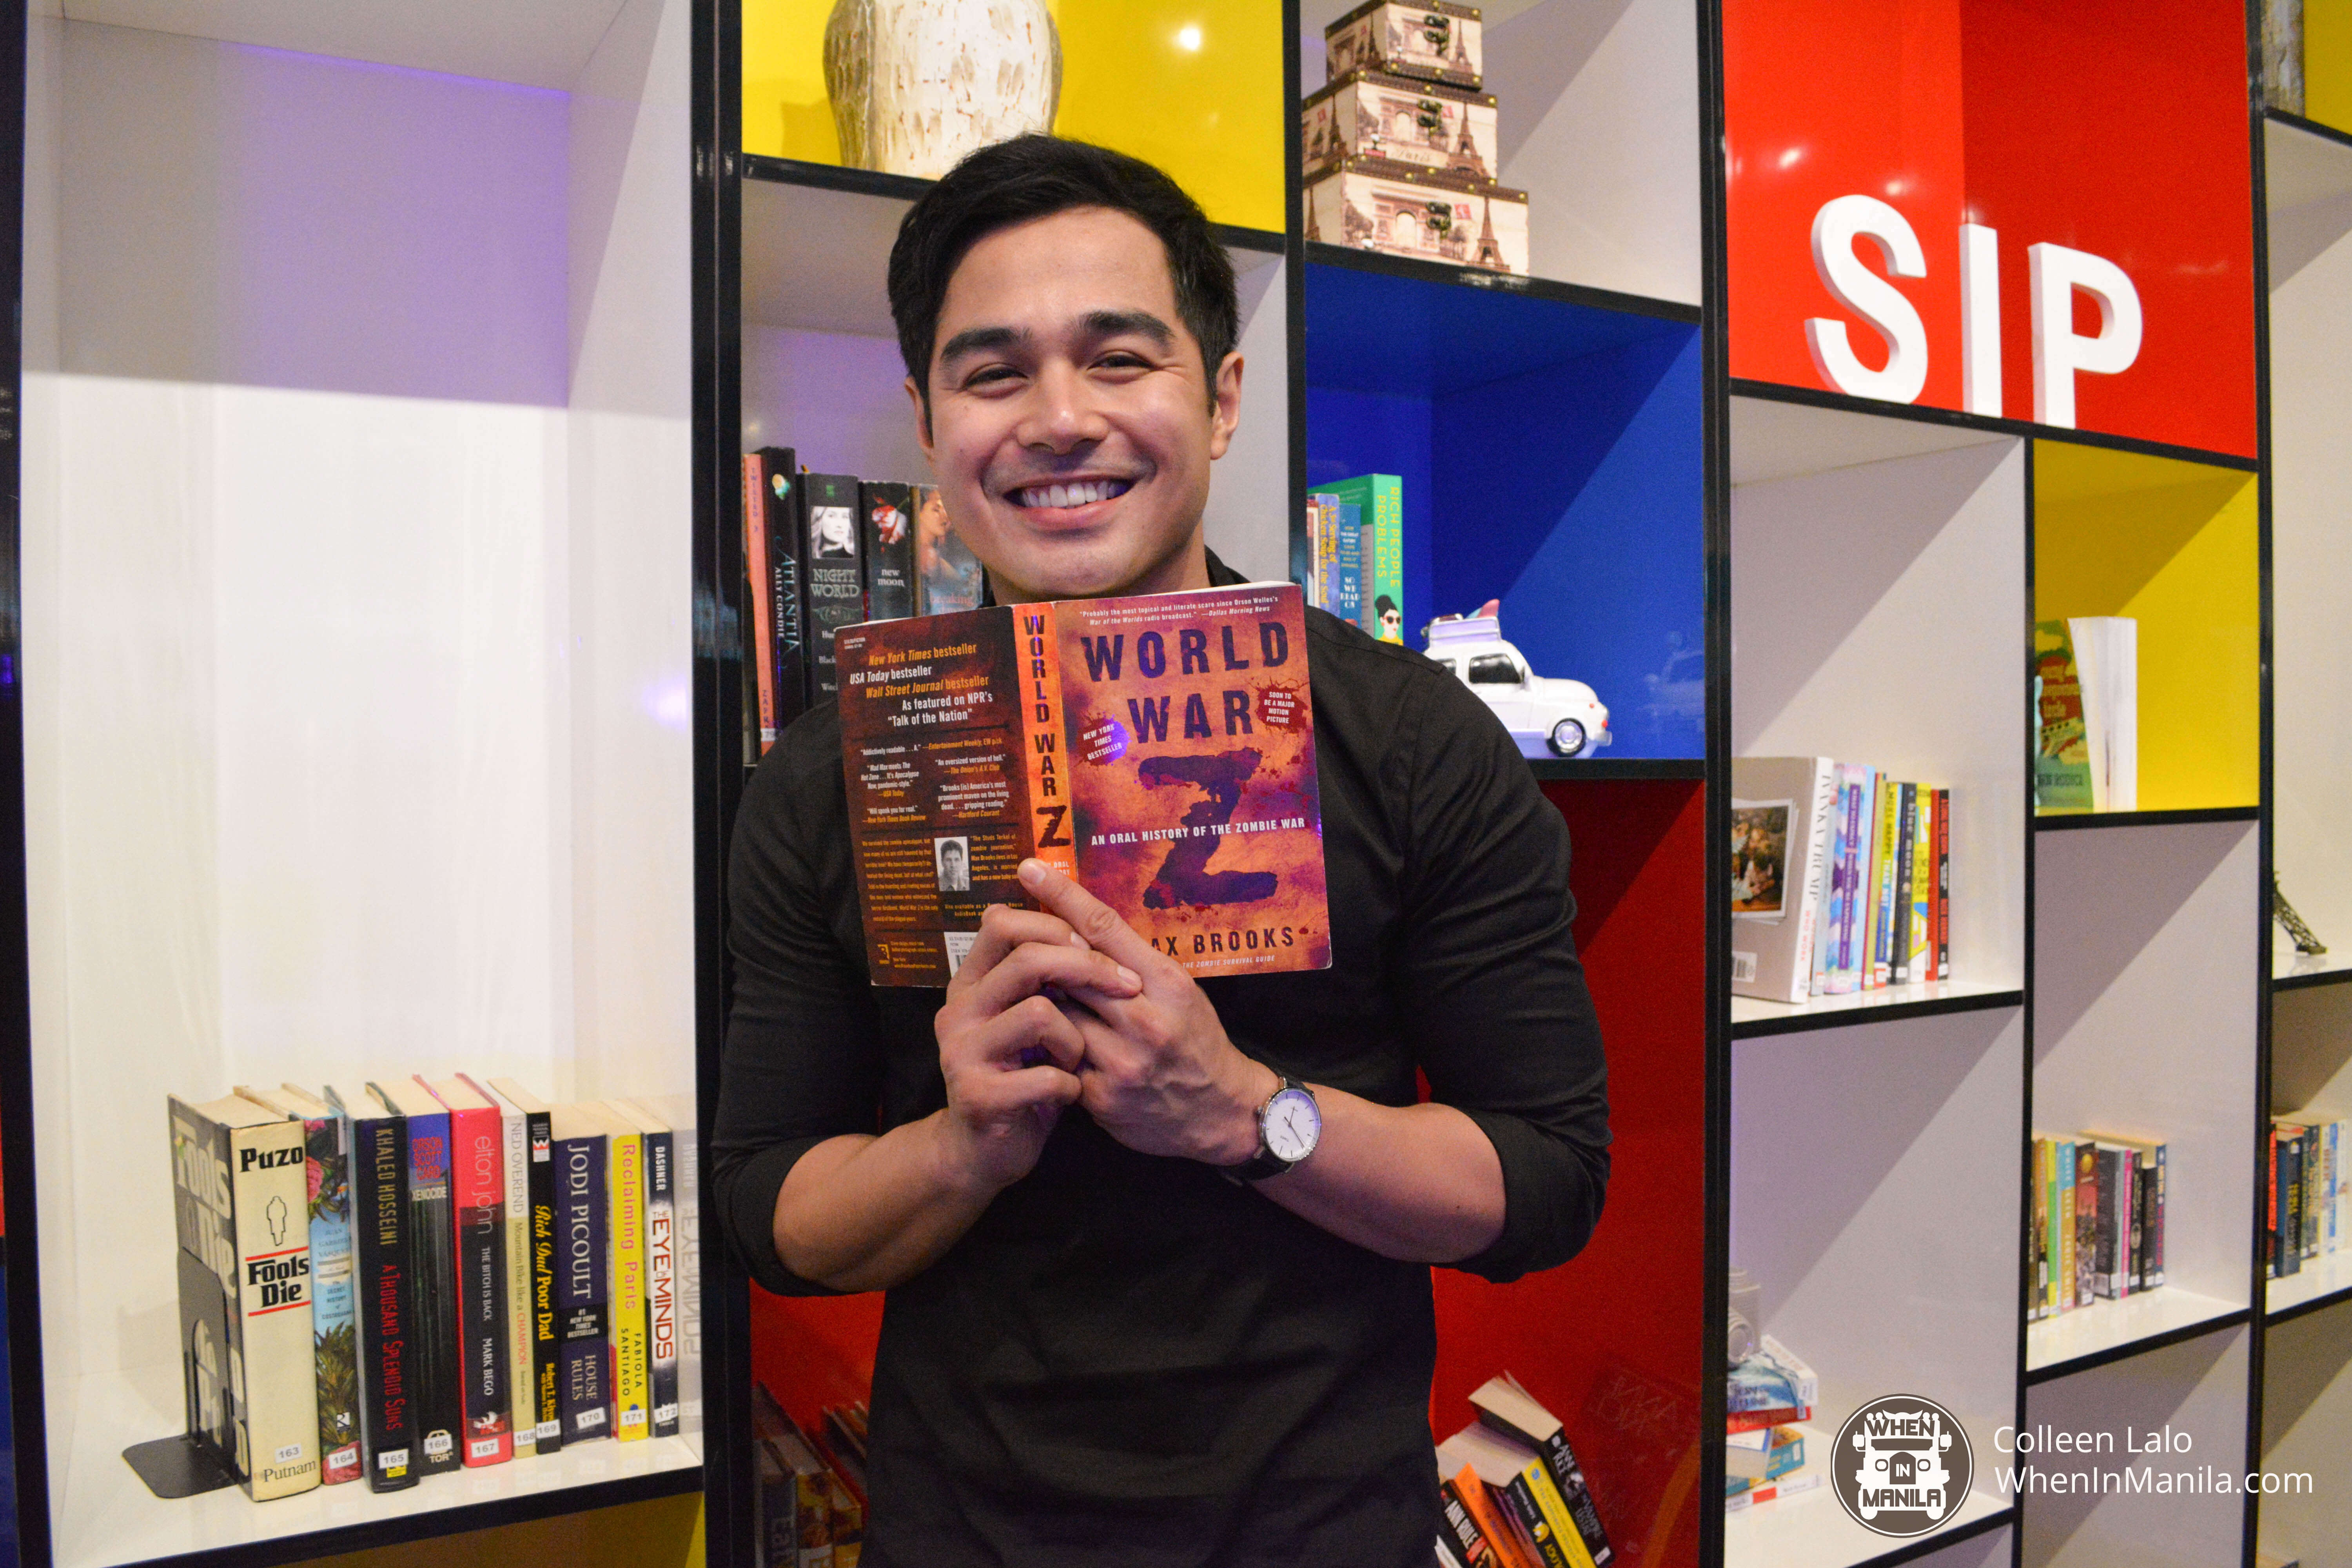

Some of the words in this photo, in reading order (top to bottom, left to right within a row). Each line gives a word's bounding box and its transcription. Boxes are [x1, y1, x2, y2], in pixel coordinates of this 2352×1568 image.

[1804, 194, 2143, 429] SIP
[1390, 486, 1399, 524] RICH
[1319, 537, 1328, 557] Soup
[1376, 495, 1387, 578] PROBLEMS
[1390, 528, 1400, 587] PEOPLE
[775, 567, 783, 592] ALLY
[813, 569, 856, 583] NIGHT
[878, 578, 904, 586] moon
[778, 544, 800, 658] ATLANTIA
[810, 584, 860, 598] WORLD
[1080, 610, 1109, 618] “Probably
[1138, 606, 1159, 615] topical
[1161, 612, 1197, 621] broadcast.”
[1229, 607, 1253, 615] Morning
[869, 655, 885, 666] New
[887, 652, 906, 663] York
[908, 650, 931, 661] Times
[933, 644, 976, 658] bestseller
[1081, 622, 1289, 682] WORLD
[850, 672, 864, 684] USA
[867, 671, 890, 683] Today
[891, 665, 932, 680] bestseller
[1023, 615, 1049, 724] WORLD
[866, 687, 883, 699] Wall
[886, 684, 909, 697] Street
[912, 679, 944, 693] Journal
[946, 676, 989, 690] bestseller
[902, 700, 912, 711] As
[914, 695, 951, 710] featured
[954, 695, 965, 706] on
[967, 691, 993, 704] NPR's
[888, 715, 909, 728] “Talk
[911, 714, 920, 725] of
[922, 712, 936, 724] the
[939, 708, 972, 722] Nation”
[1127, 690, 1253, 744] WAR
[1083, 731, 1097, 740] NEW
[1099, 724, 1115, 735] YORK
[1094, 735, 1112, 747] TIMES
[1034, 733, 1056, 797] WAR
[1087, 742, 1122, 760] BESTSELLER
[938, 793, 963, 802] prominent
[996, 790, 1009, 799] living
[1816, 775, 1831, 835] IVANKA
[1036, 805, 1071, 848] Z
[1091, 835, 1105, 846] AN
[1109, 833, 1138, 844] ORAL
[1142, 828, 1189, 841] HISTORY
[1193, 826, 1206, 837] OF
[1212, 824, 1231, 835] THE
[1236, 820, 1276, 833] ZOMBIE
[1281, 818, 1305, 828] WAR
[1138, 746, 1279, 910] Z
[1906, 803, 1915, 834] blue
[1809, 844, 1823, 900] TRUMP
[1151, 936, 1179, 956] AX
[1193, 927, 1294, 955] BROOKS
[1196, 960, 1221, 968] ZOMBIE
[412, 1136, 443, 1152] ORSON
[511, 1123, 521, 1150] NED
[240, 1146, 304, 1173] Puzo
[376, 1128, 395, 1181] KHALED
[414, 1151, 442, 1167] SCOTT
[474, 1136, 495, 1186] elton
[655, 1146, 668, 1191] DASHNER
[416, 1165, 441, 1181] CARD
[512, 1152, 523, 1213] OVEREND
[568, 1144, 590, 1196] JODI
[412, 1187, 447, 1201] XENOCIDE
[621, 1144, 636, 1250] Reclaiming
[378, 1183, 397, 1245] HOSSEINI
[472, 1191, 496, 1234] john
[535, 1205, 552, 1238] Rich
[652, 1210, 669, 1218] THE
[482, 1246, 490, 1262] THE
[514, 1223, 523, 1264] Mountain
[535, 1241, 552, 1274] Dad
[571, 1204, 591, 1299] PICOULT
[653, 1218, 670, 1272] EYE
[247, 1255, 309, 1286] Fools
[482, 1265, 491, 1288] BITCH
[515, 1265, 525, 1285] Bike
[260, 1279, 302, 1308] Die
[516, 1286, 526, 1303] like
[537, 1276, 552, 1309] Poor
[625, 1261, 638, 1310] Paris
[380, 1273, 400, 1336] THOUSAND
[483, 1300, 492, 1321] BACK
[654, 1277, 673, 1359] MINDS
[517, 1312, 527, 1365] CHAMPION
[538, 1312, 555, 1341] Dad
[567, 1328, 599, 1338] BESTSELLER
[483, 1338, 493, 1367] MARK
[621, 1328, 630, 1396] SANTIAGO
[634, 1333, 644, 1388] FABIOLA
[383, 1340, 404, 1396] SPLENDID
[571, 1359, 583, 1400] RULES
[585, 1355, 598, 1400] HOUSE
[483, 1369, 494, 1396] BEGO
[384, 1398, 406, 1431] SUNS
[581, 1413, 600, 1423] 170
[624, 1412, 642, 1421] 171
[659, 1407, 677, 1419] 172
[516, 1433, 535, 1442] 168
[537, 1424, 556, 1434] 169
[279, 1446, 300, 1458] 163
[428, 1439, 448, 1449] 166
[476, 1443, 495, 1454] 167
[264, 1460, 317, 1483] Putnam
[333, 1453, 354, 1465] 164
[383, 1454, 405, 1465] 165
